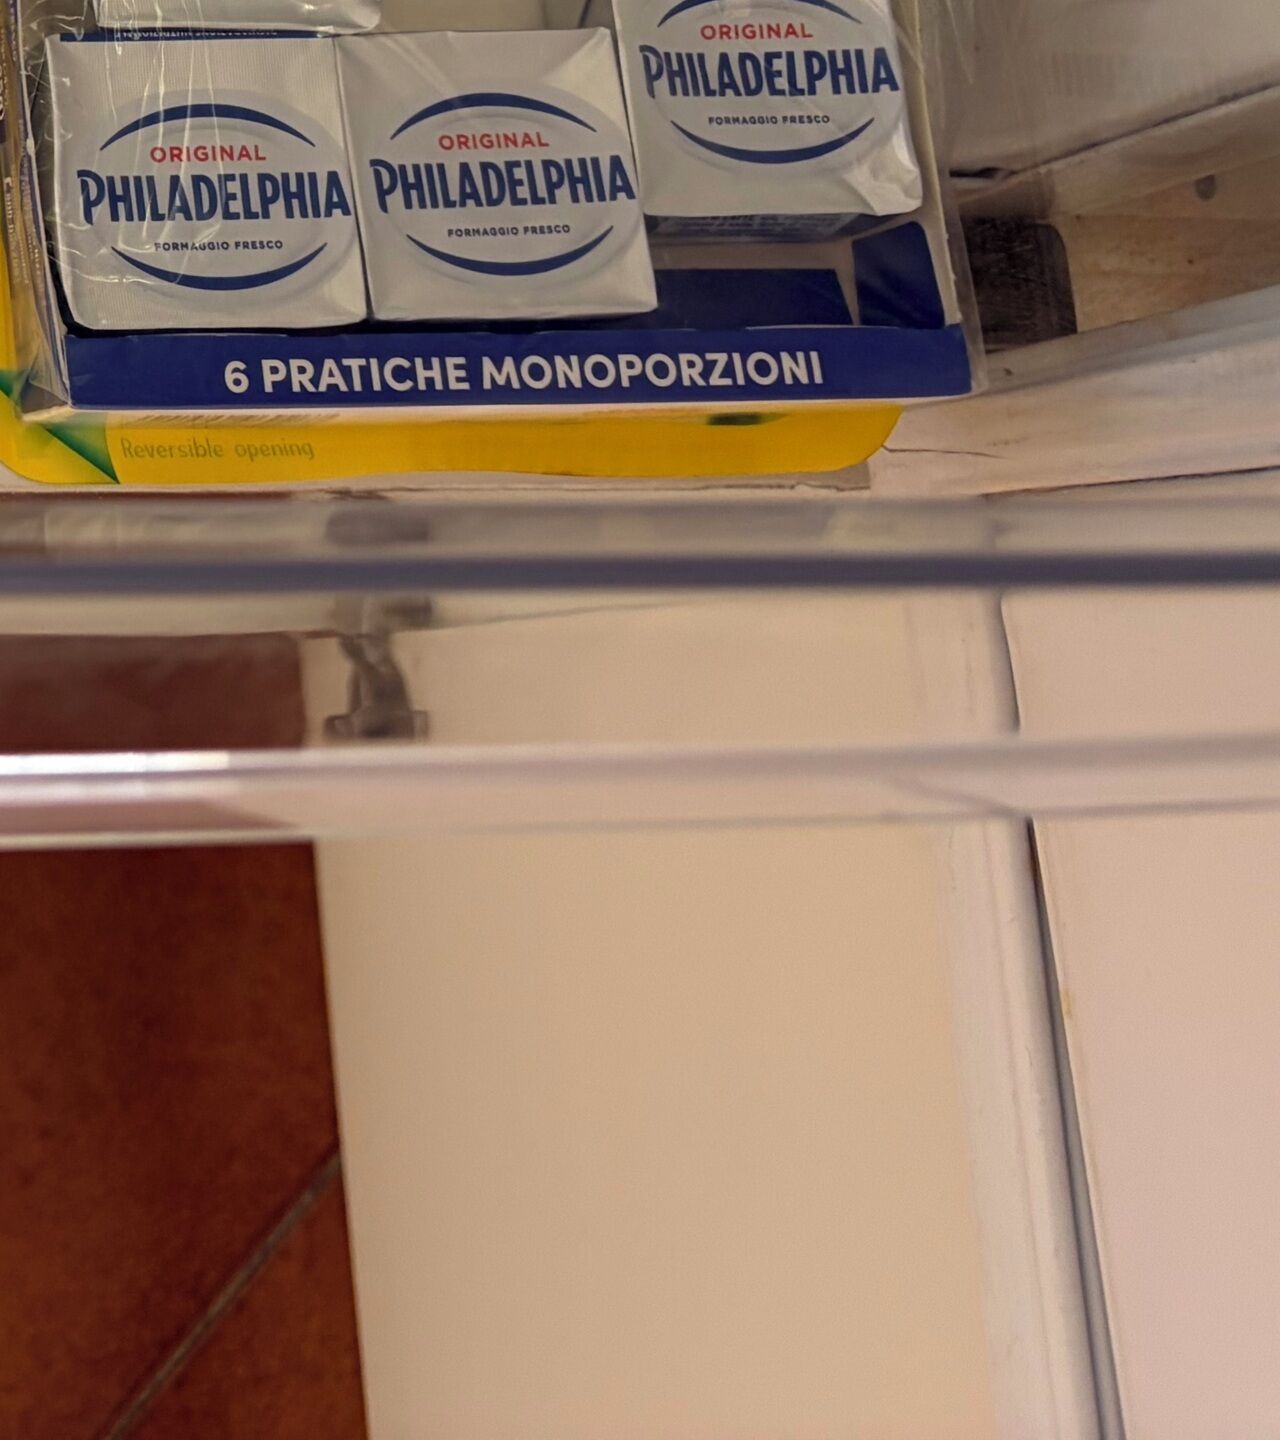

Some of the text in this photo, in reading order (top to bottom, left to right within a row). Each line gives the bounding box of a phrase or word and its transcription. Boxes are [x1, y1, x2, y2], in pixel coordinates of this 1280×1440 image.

[699, 22, 814, 41] ORIGINAL
[638, 44, 900, 100] PHILADELPHIA
[708, 114, 831, 126] FORMAGGIO FRESCO
[438, 131, 551, 151] ORIGINAL
[149, 143, 268, 164] ORIGINAL
[368, 154, 637, 214] PHILADELPHIA
[76, 168, 353, 226] PHILADELPHIA
[446, 223, 571, 238] FORMAGGIO FRESCO
[154, 239, 284, 253] FORMAGGIO FRESCO
[223, 350, 825, 395] 6 PRATICHE MONOPORZIONI
[120, 437, 316, 462] Reversible opening
